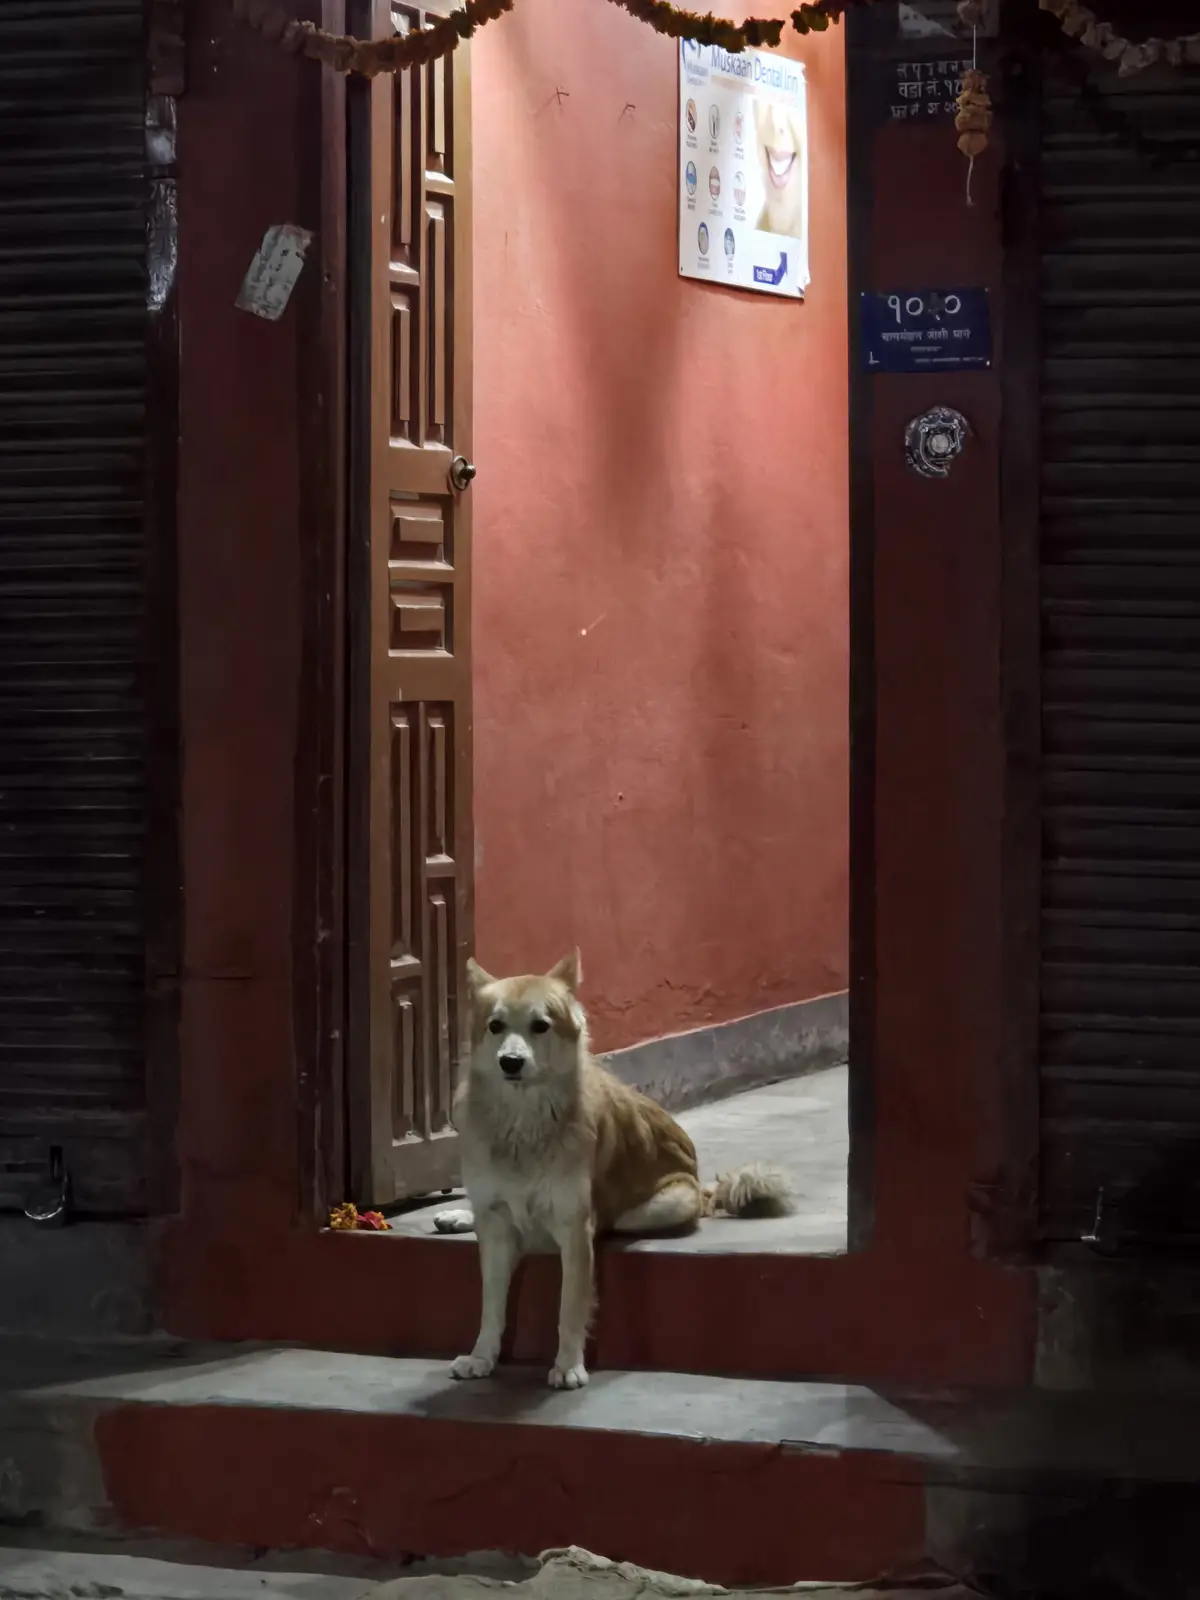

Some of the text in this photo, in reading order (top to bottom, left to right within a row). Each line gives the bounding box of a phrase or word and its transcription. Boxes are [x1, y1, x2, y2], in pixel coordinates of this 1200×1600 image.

[711, 46, 753, 80] Muskaan
[754, 57, 783, 89] Dental
[887, 294, 961, 324] १००
